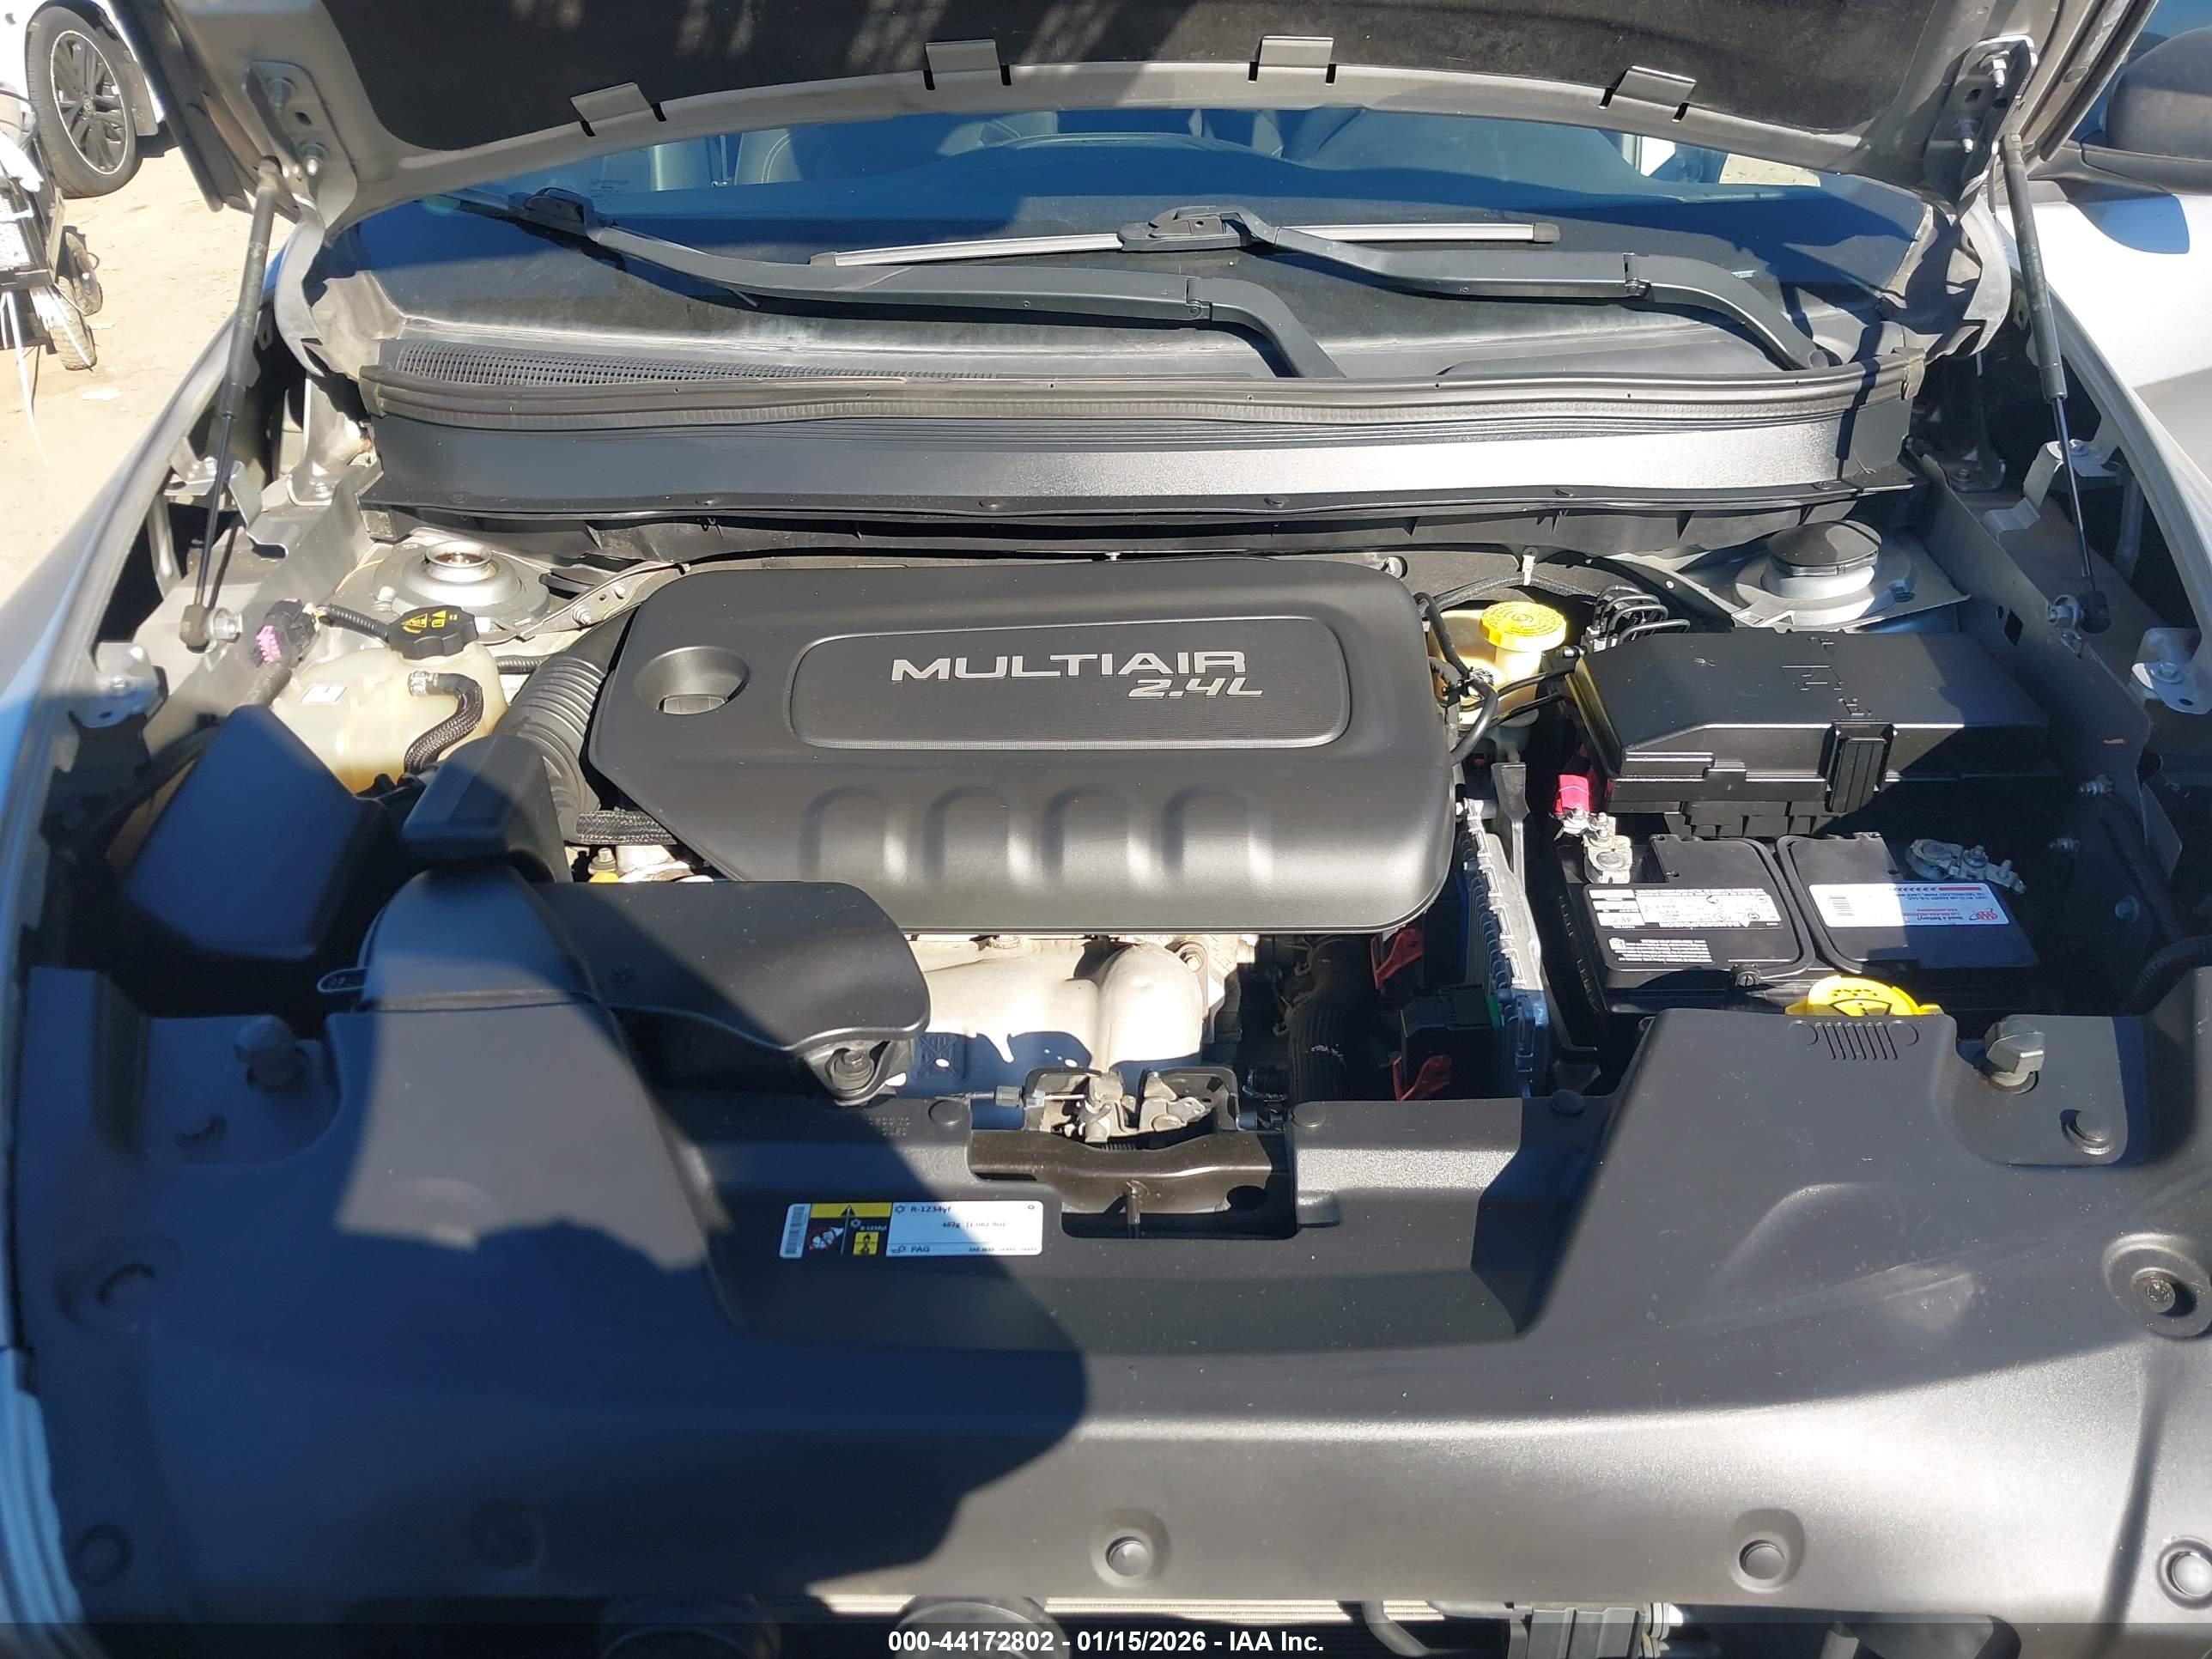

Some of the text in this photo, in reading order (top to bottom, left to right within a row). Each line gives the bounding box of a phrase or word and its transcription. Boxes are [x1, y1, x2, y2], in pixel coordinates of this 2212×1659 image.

[890, 651, 1246, 682] MULTIAIR
[1127, 677, 1263, 699] 2.4L
[910, 1205, 951, 1213] R-1234yf
